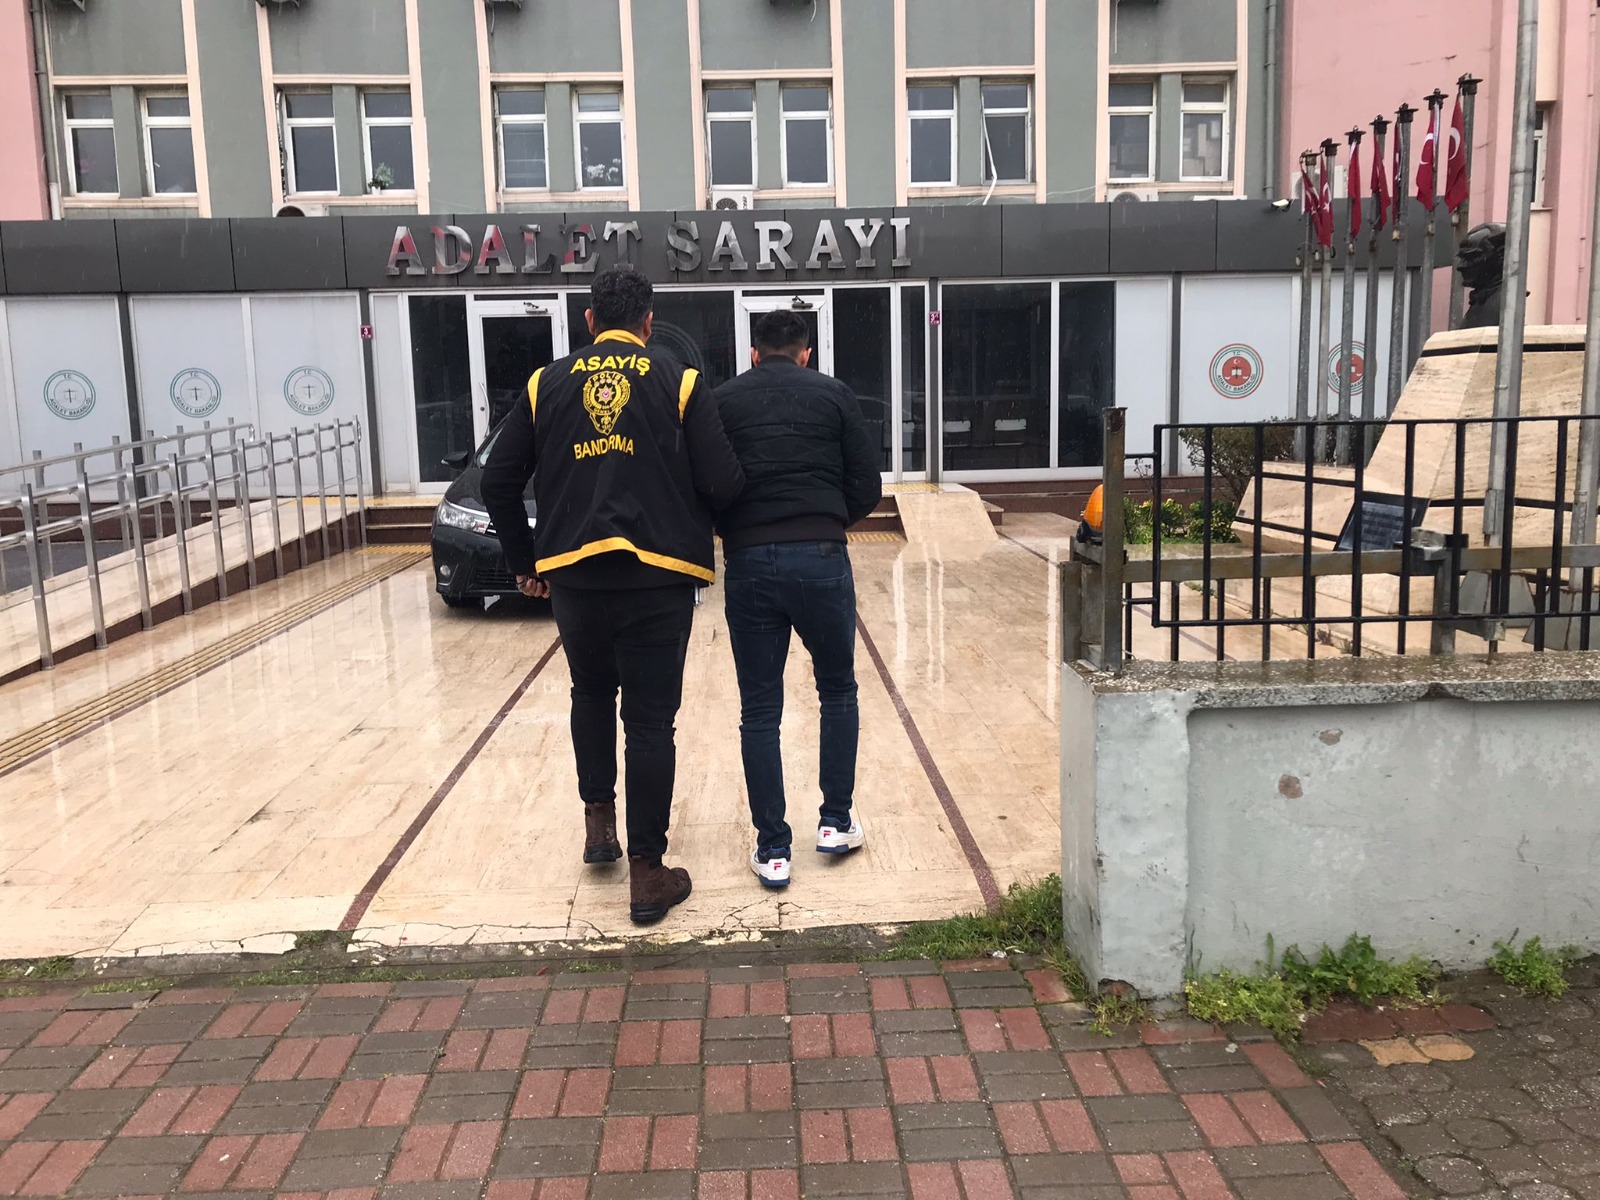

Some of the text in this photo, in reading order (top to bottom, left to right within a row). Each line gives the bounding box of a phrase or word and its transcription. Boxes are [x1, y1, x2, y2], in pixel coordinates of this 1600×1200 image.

[386, 217, 911, 276] ADALET SARAYI
[570, 354, 650, 376] ASAYİŞ
[574, 434, 634, 460] BANDRMA
